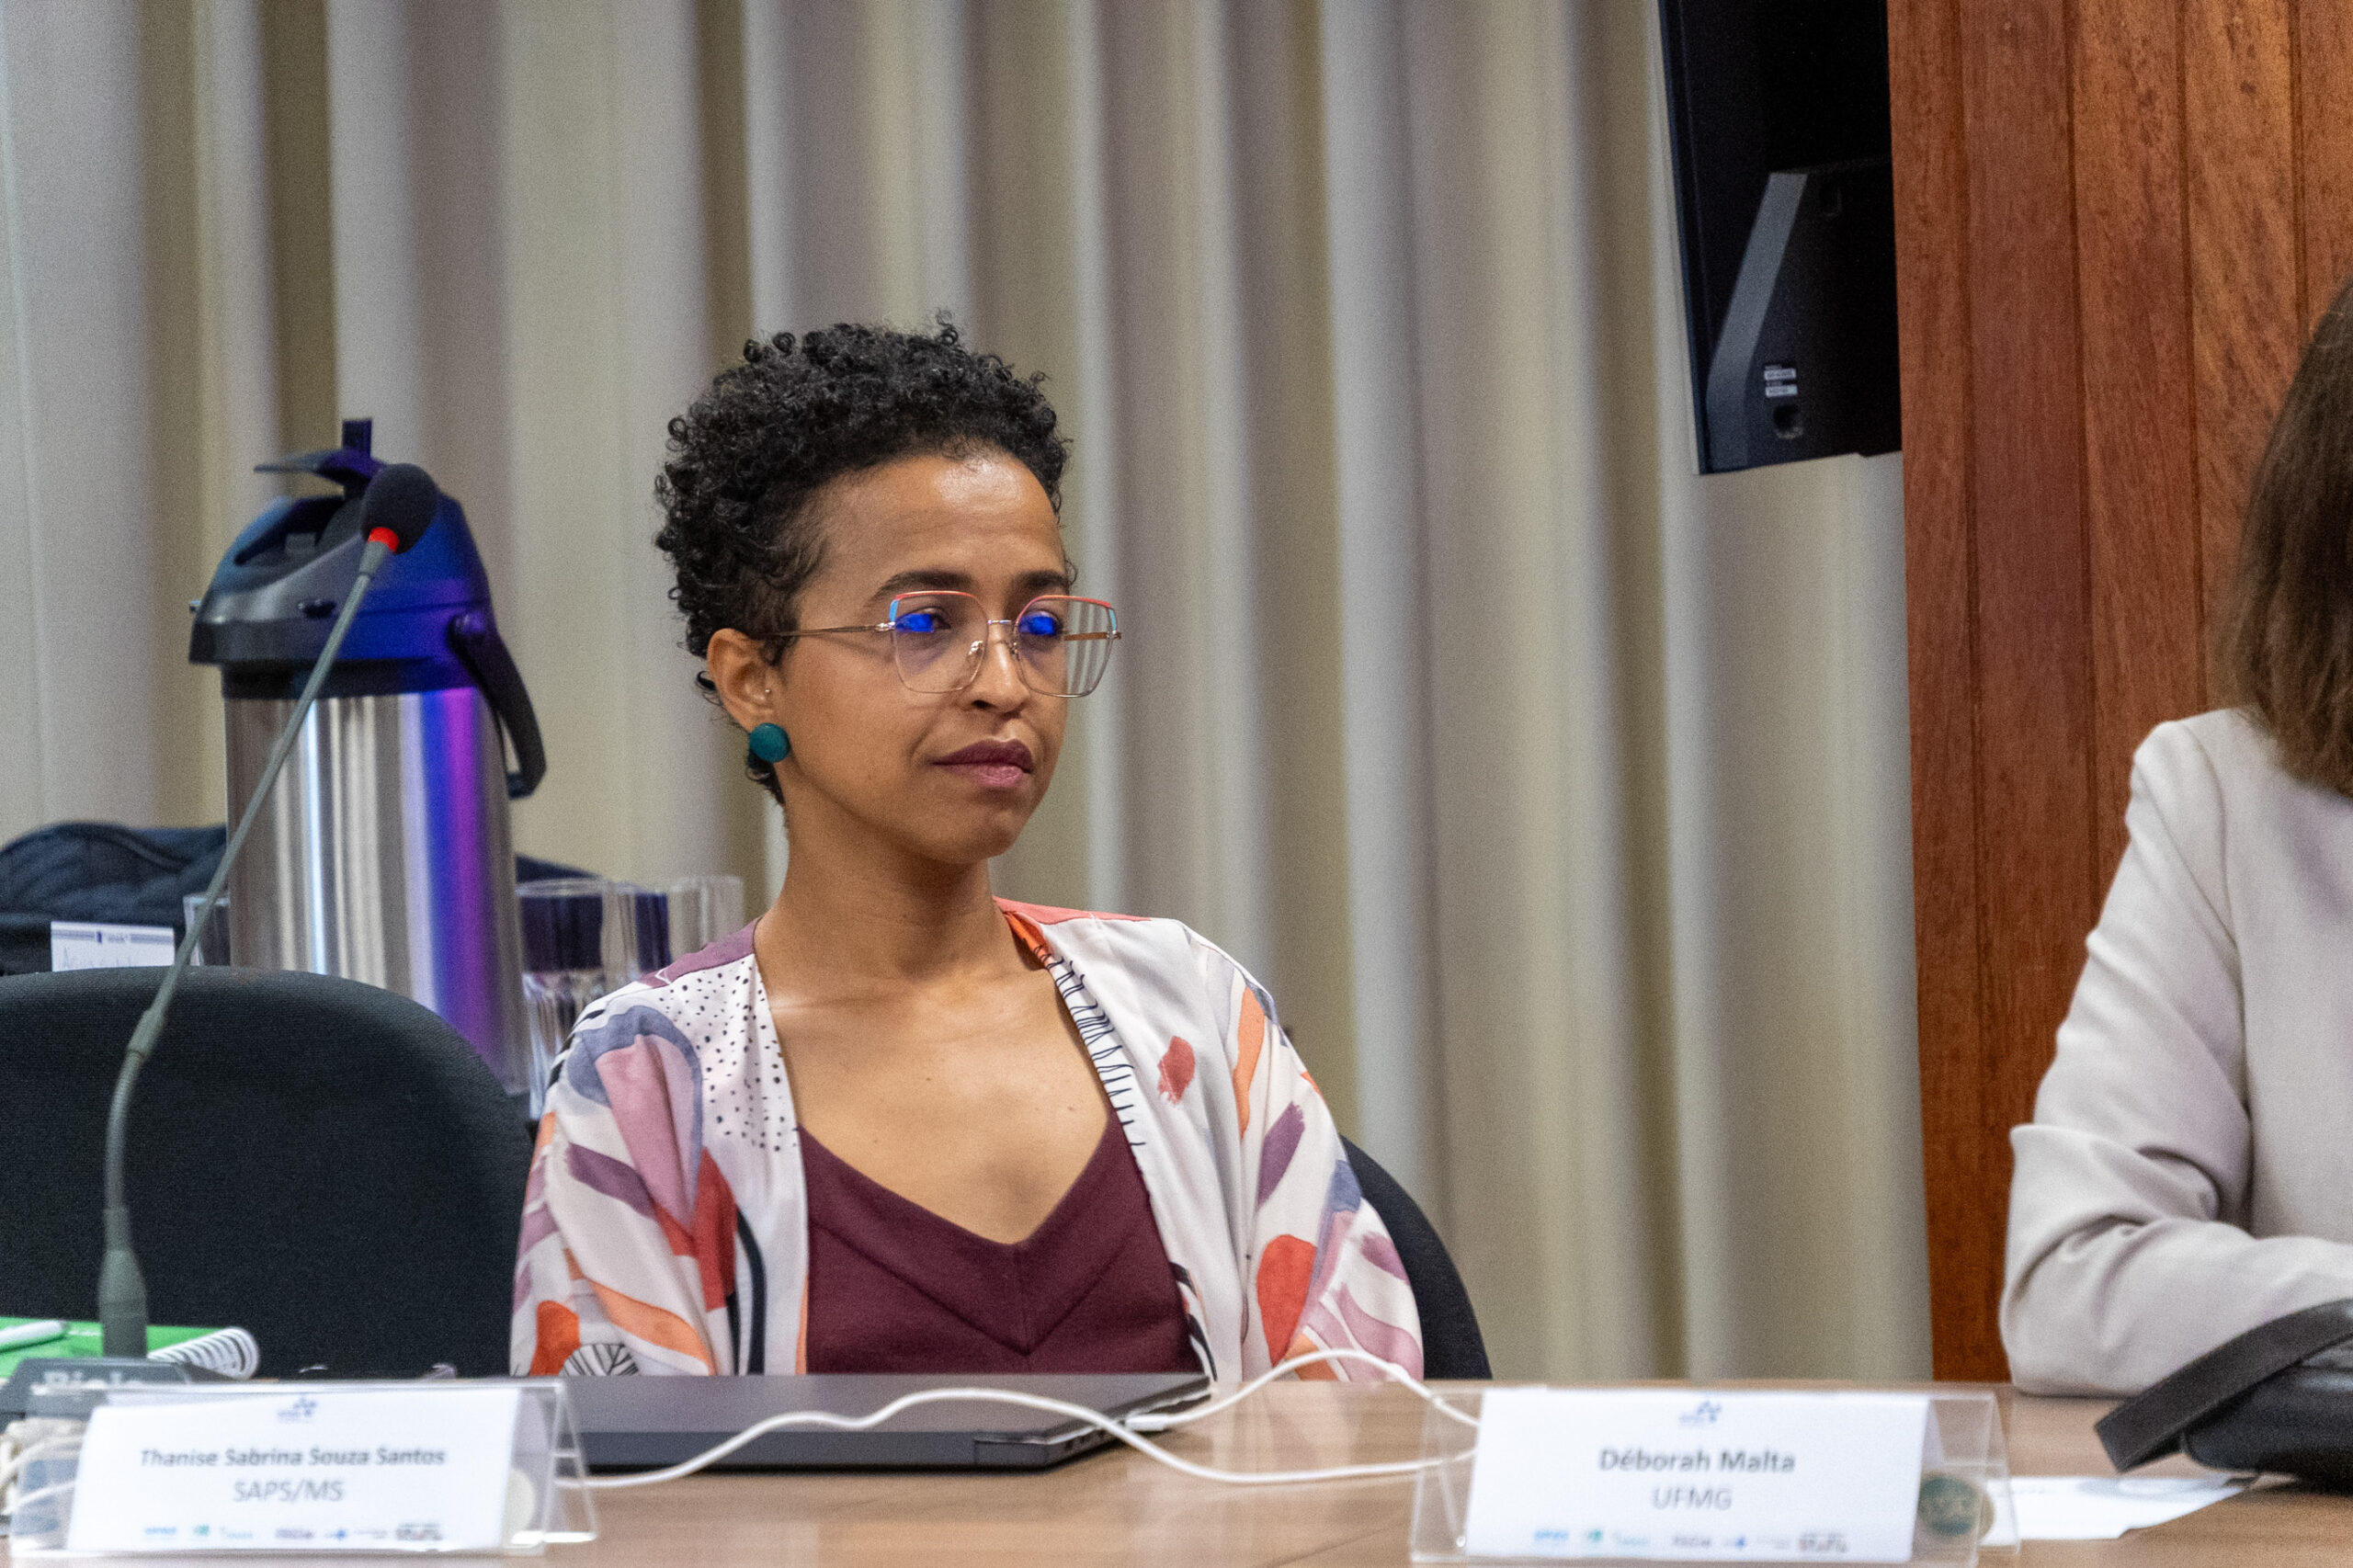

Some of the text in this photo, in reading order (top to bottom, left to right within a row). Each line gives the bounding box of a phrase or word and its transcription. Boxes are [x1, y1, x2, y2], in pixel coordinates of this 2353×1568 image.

[141, 1446, 446, 1466] Thanise Sabrina Souza Santos
[1599, 1447, 1797, 1471] Déborah Malta
[233, 1479, 345, 1503] SAPS/MS
[1653, 1486, 1733, 1511] UFMG
